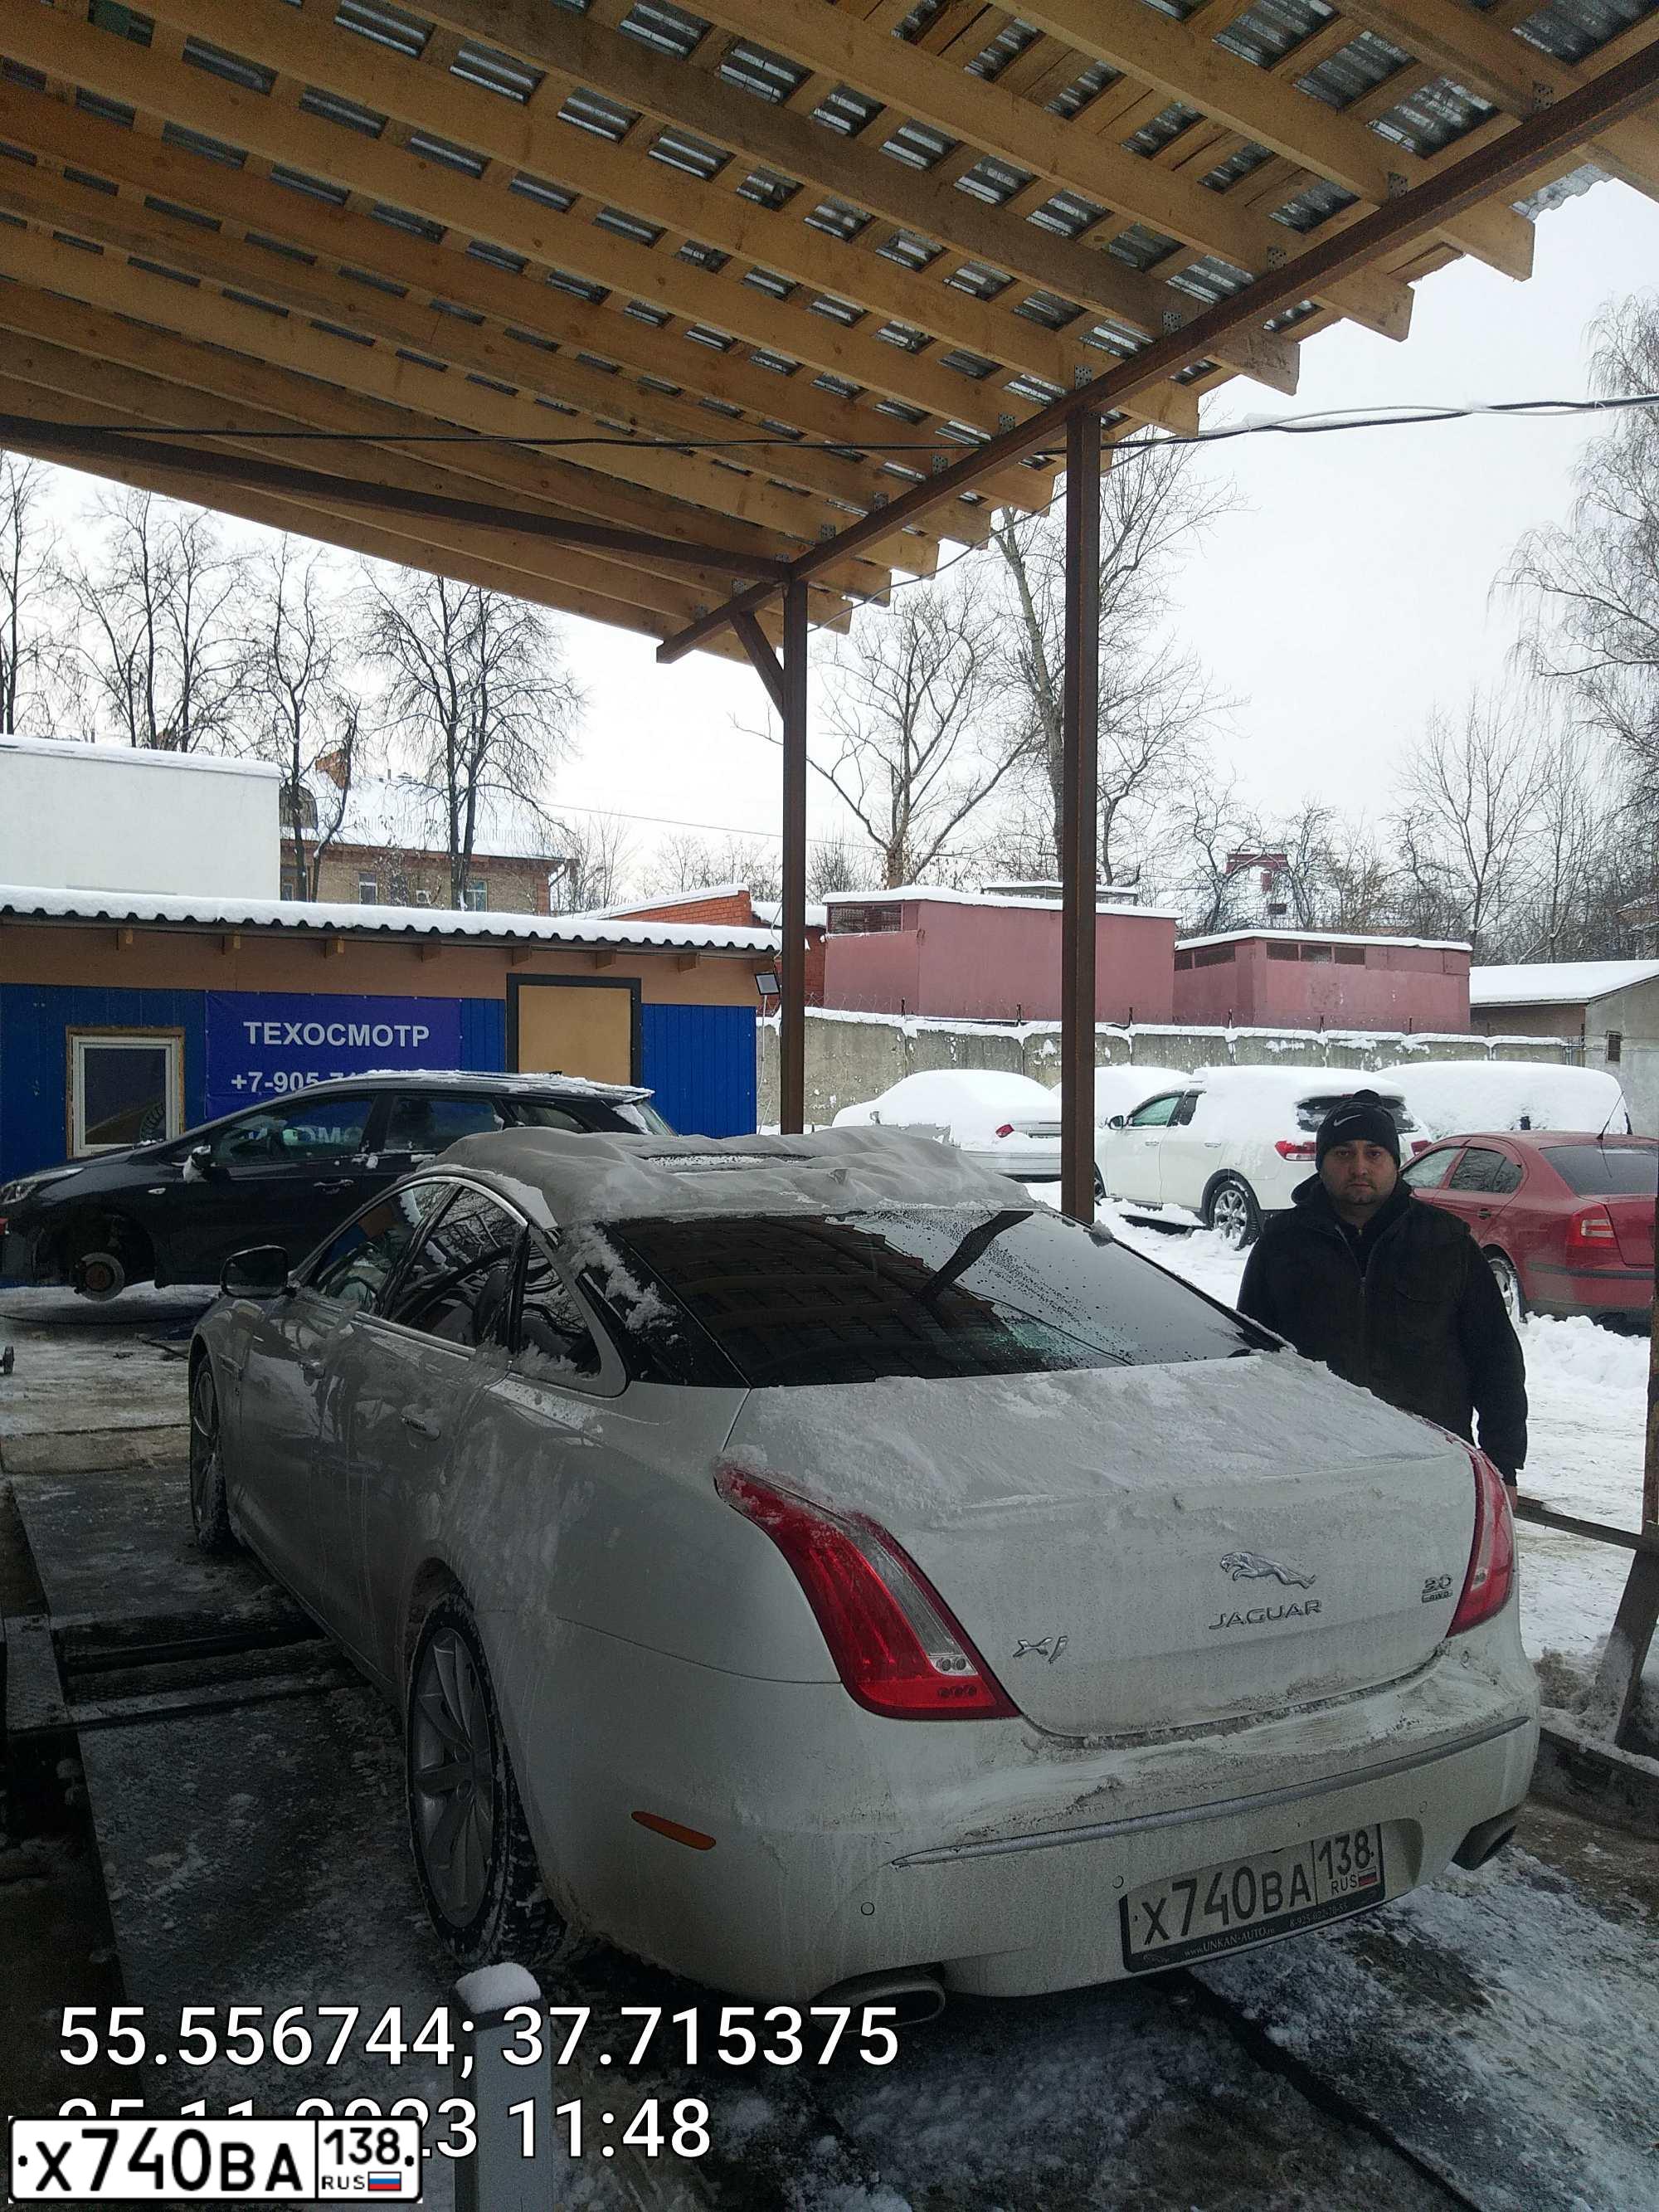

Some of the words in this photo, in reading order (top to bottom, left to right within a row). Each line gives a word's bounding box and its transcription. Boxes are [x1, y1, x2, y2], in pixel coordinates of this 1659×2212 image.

[243, 1021, 430, 1047] ТЕХОСМОТР
[1209, 1600, 1321, 1630] JAGUAR
[1013, 1635, 1068, 1664] XJ
[1318, 1830, 1371, 1880] 138
[1331, 1873, 1359, 1897] RUS
